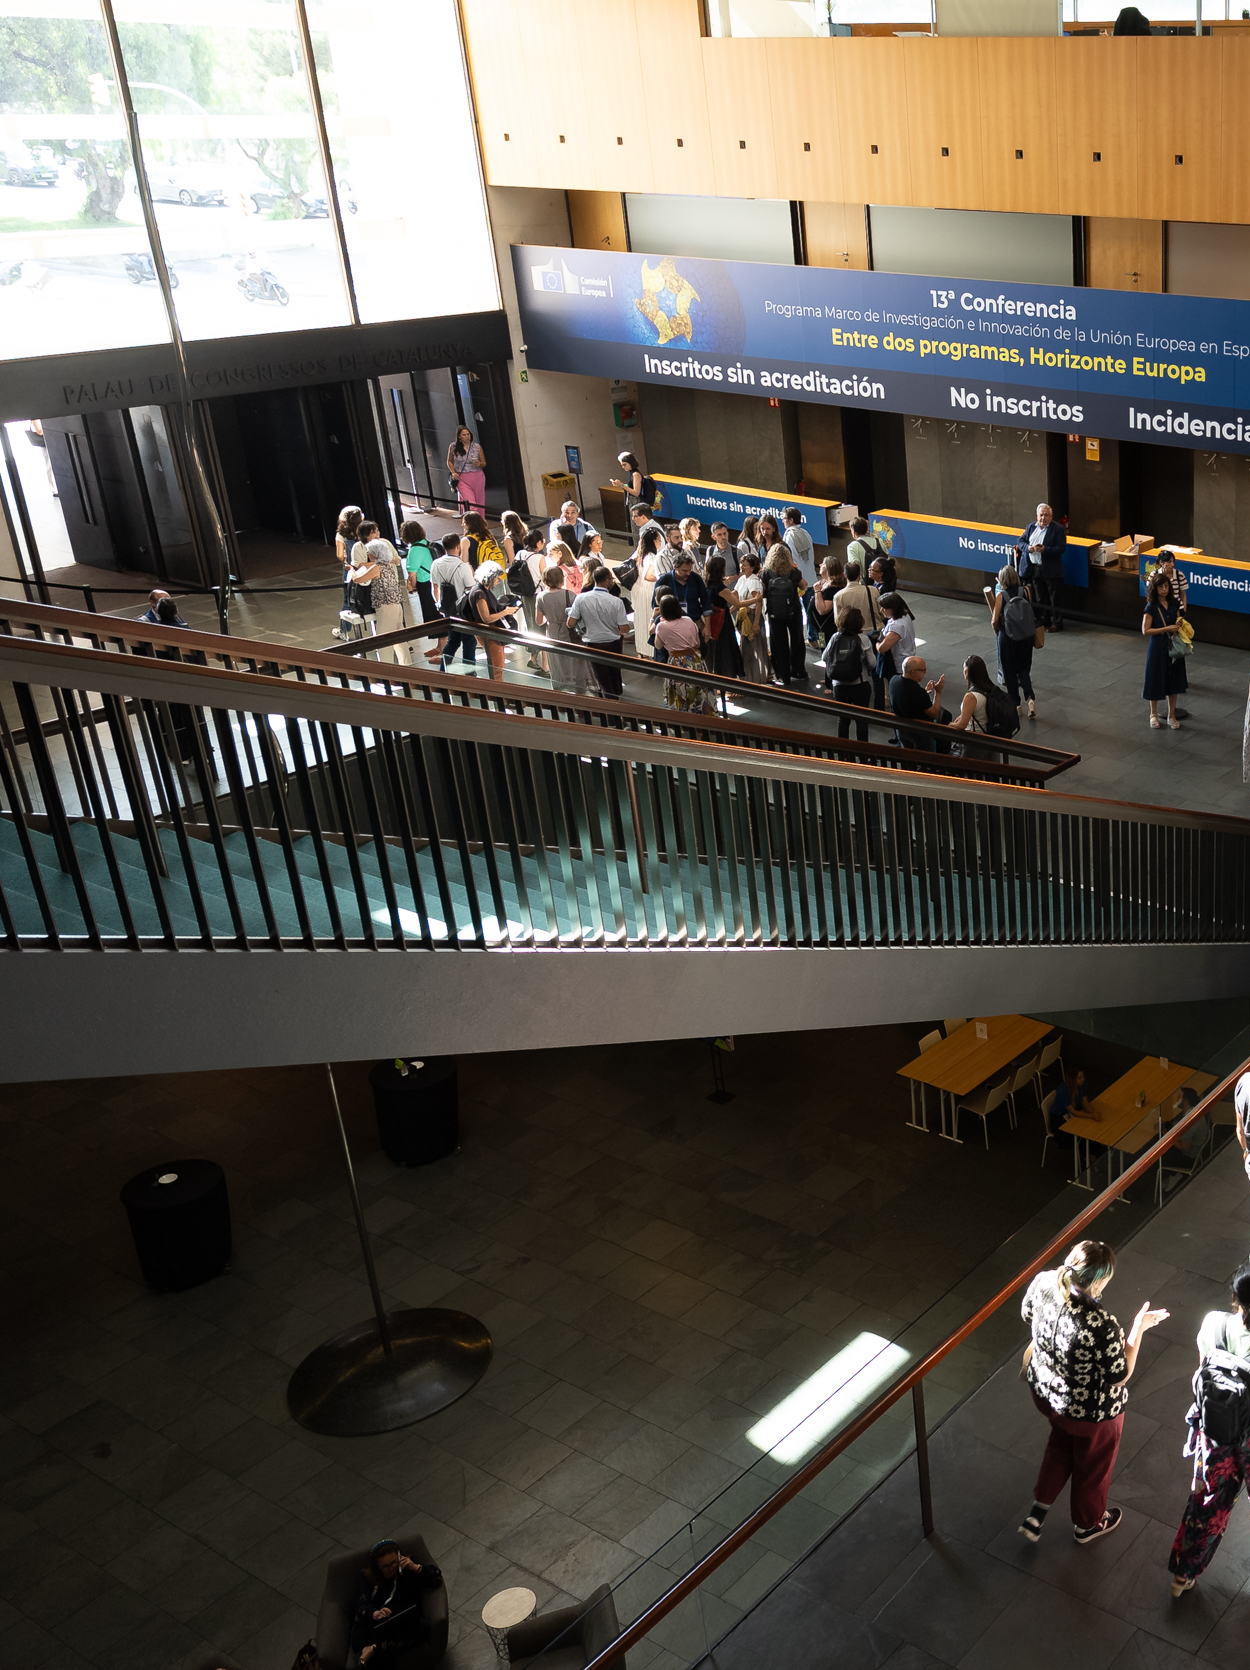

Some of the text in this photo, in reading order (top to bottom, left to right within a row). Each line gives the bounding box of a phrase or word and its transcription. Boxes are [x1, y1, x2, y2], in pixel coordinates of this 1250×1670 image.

[580, 276, 608, 288] Comisión
[581, 287, 607, 298] Europea
[929, 289, 1077, 321] 13ª Conferencia
[764, 300, 822, 320] Programa
[824, 306, 862, 322] Marco
[864, 309, 880, 323] de
[882, 310, 964, 331] Investigación
[967, 320, 976, 332] e
[978, 318, 1050, 339] Innovación
[1053, 326, 1071, 341] de
[1075, 327, 1086, 342] la
[1090, 329, 1132, 346] Unión
[1136, 333, 1196, 353] Europea
[1199, 340, 1218, 355] en
[62, 341, 472, 405] PALAU DE CONGRESSOS DE CATALUNYA
[831, 328, 1207, 385] Entre dos programas, Horizonte Europa
[643, 354, 886, 400] Inscritos sin acreditación
[950, 387, 1084, 422] No inscritos
[686, 494, 807, 524] Inscritos sin acreditan
[958, 536, 1013, 556] No inscrit
